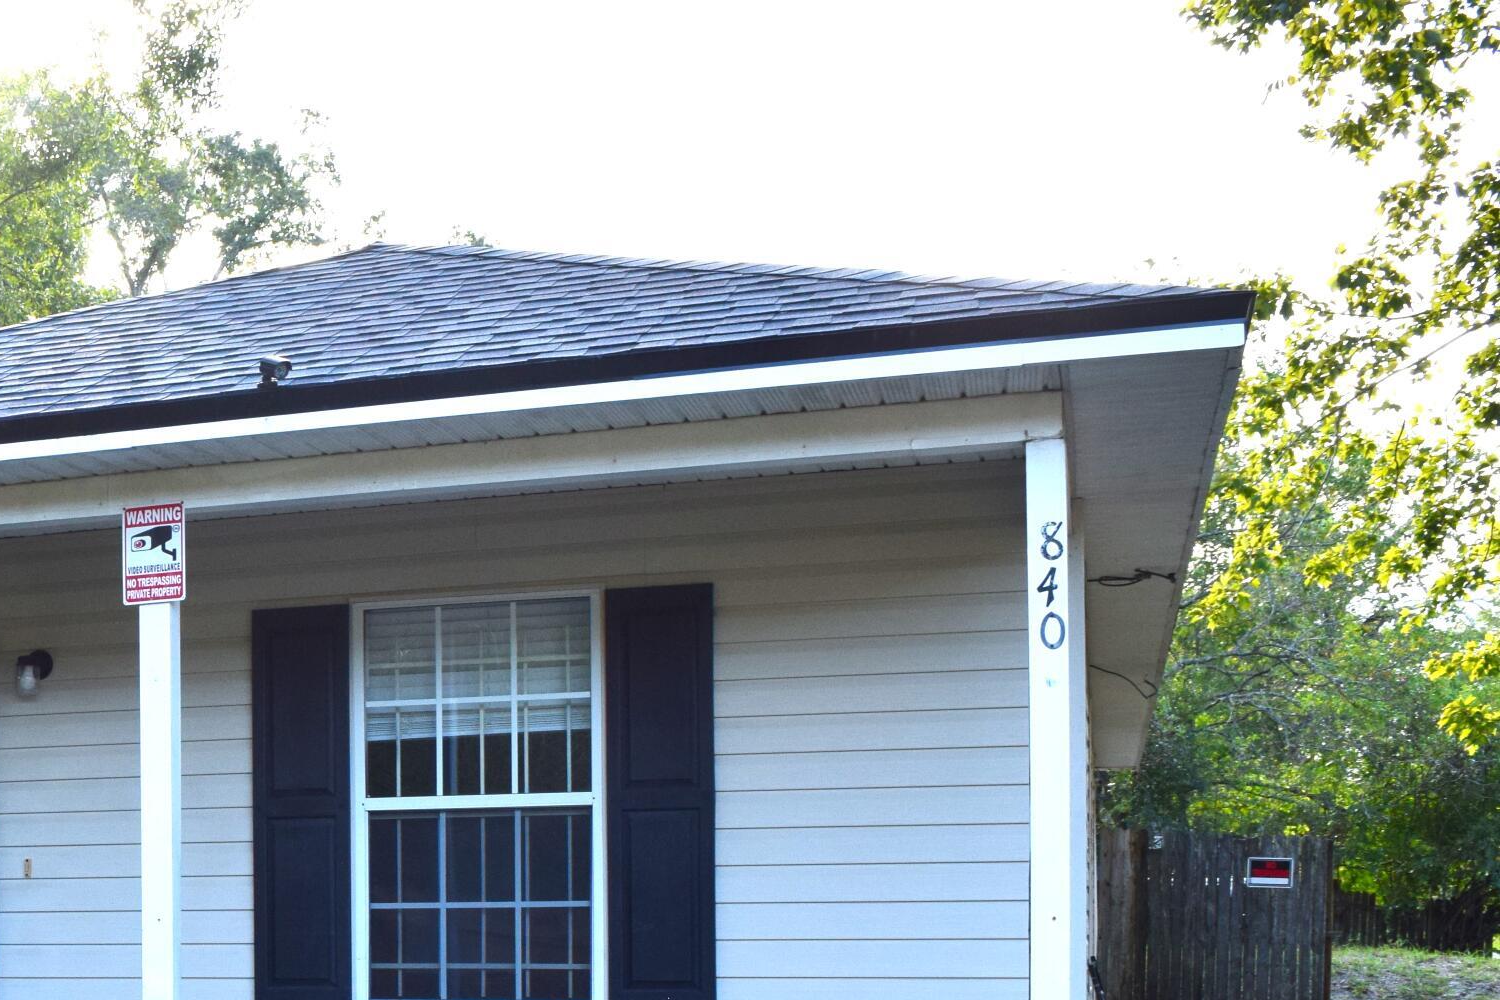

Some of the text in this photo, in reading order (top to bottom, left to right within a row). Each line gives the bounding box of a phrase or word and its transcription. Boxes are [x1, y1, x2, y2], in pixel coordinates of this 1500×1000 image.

[126, 507, 181, 525] WARNING
[128, 562, 180, 574] VIDEO SURVEILLANCE
[127, 575, 181, 589] NO TRESPASSING
[1037, 521, 1065, 650] 840
[127, 586, 181, 600] PRIVATE PROPERTY
